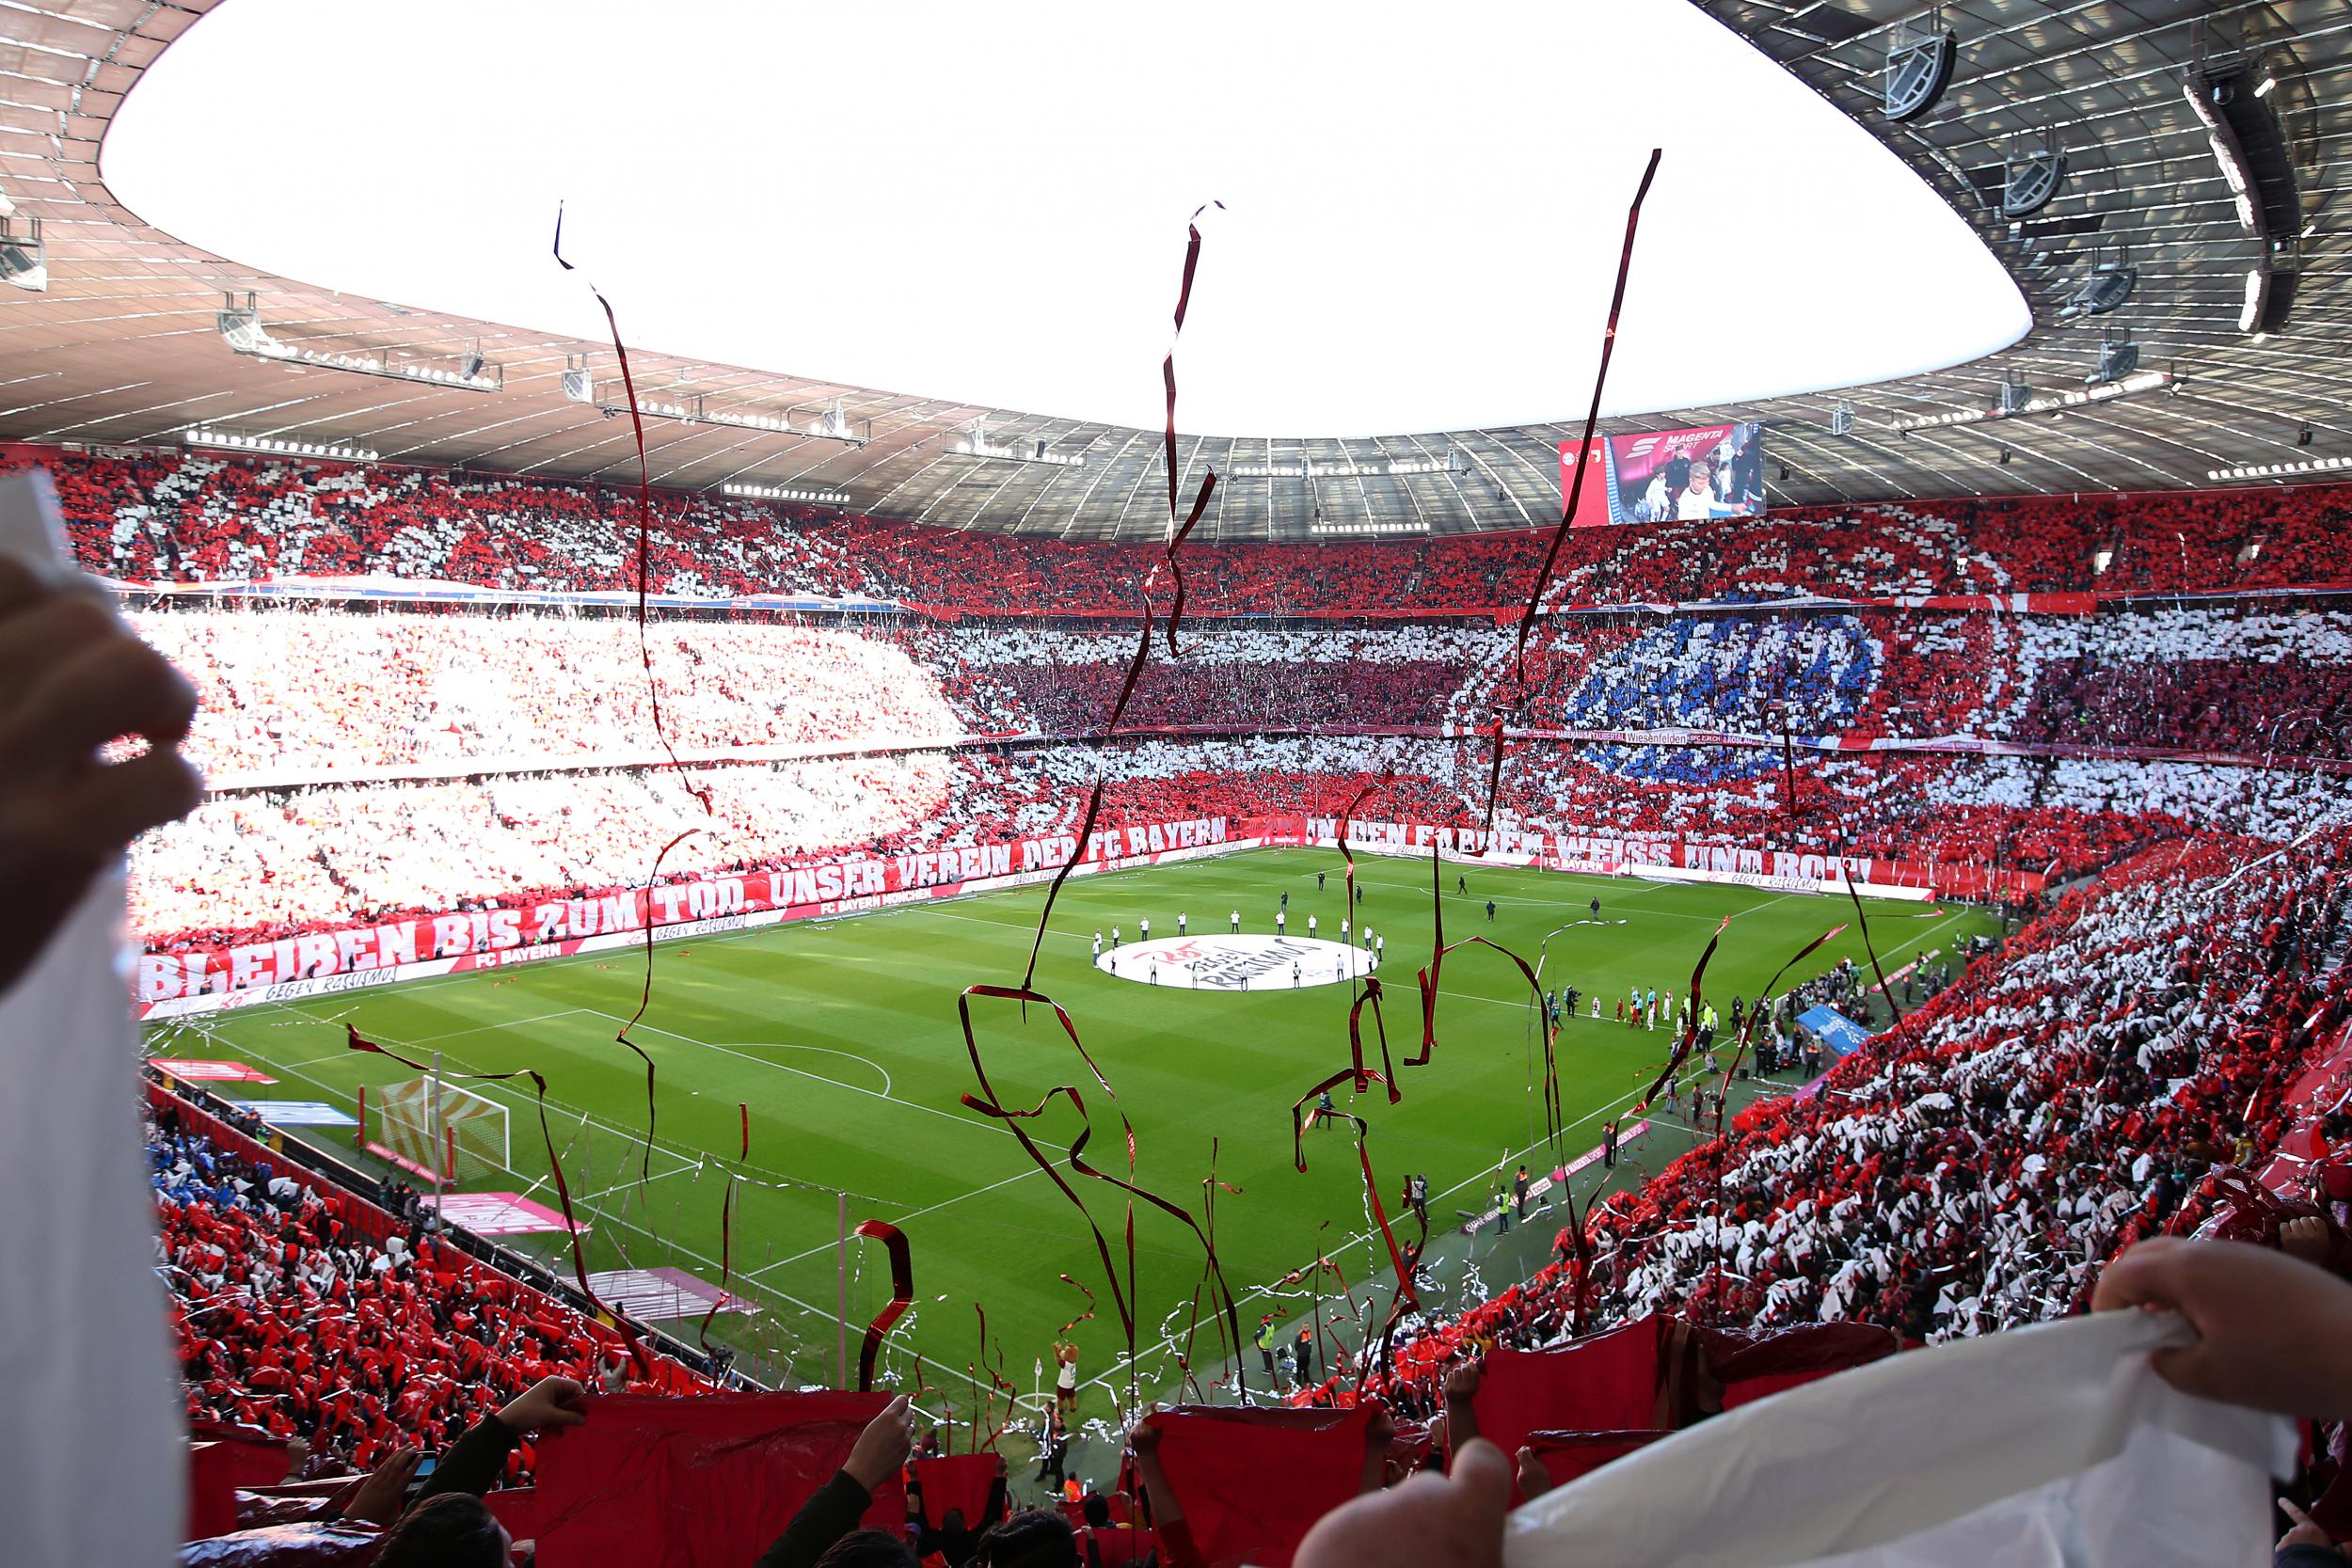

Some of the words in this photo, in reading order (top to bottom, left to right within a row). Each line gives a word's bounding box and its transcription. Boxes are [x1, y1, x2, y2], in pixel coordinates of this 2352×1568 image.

[1666, 430, 1724, 444] MAGENTA
[1592, 731, 1626, 741] TAUBERTAL
[1628, 733, 1686, 744] Wiesenfelden
[1306, 816, 1338, 840] IN
[1347, 819, 1408, 848] DEN
[1415, 824, 1544, 855] FARBEN
[1554, 835, 1672, 867] WEISS
[1684, 845, 1762, 875] UND
[1773, 850, 1872, 884] ROT!
[1108, 860, 1119, 870] FC
[1120, 855, 1151, 868] BAYERN
[1544, 857, 1558, 867] FC
[1562, 858, 1604, 871] BAYERN
[1732, 874, 1762, 884] GEGEN
[138, 921, 418, 1003] BLEIBEN
[433, 910, 522, 957] BIS
[534, 891, 639, 940] ZUM
[654, 877, 755, 922] TOD.
[769, 860, 887, 906] UNSER
[896, 843, 1011, 889] VEREIN
[1022, 835, 1078, 870] DER
[1088, 830, 1121, 862] FC
[1127, 816, 1227, 854] BAYERN
[820, 902, 836, 914] FC
[838, 895, 881, 912] BAYERN
[656, 922, 690, 940] GEGEN
[475, 952, 497, 969] FC
[501, 942, 563, 965] BAYERN
[1133, 941, 1211, 964] ROT
[1184, 945, 1254, 973] GEGEN
[265, 981, 313, 1001] GEGEN
[323, 965, 399, 990] RASSISMUS
